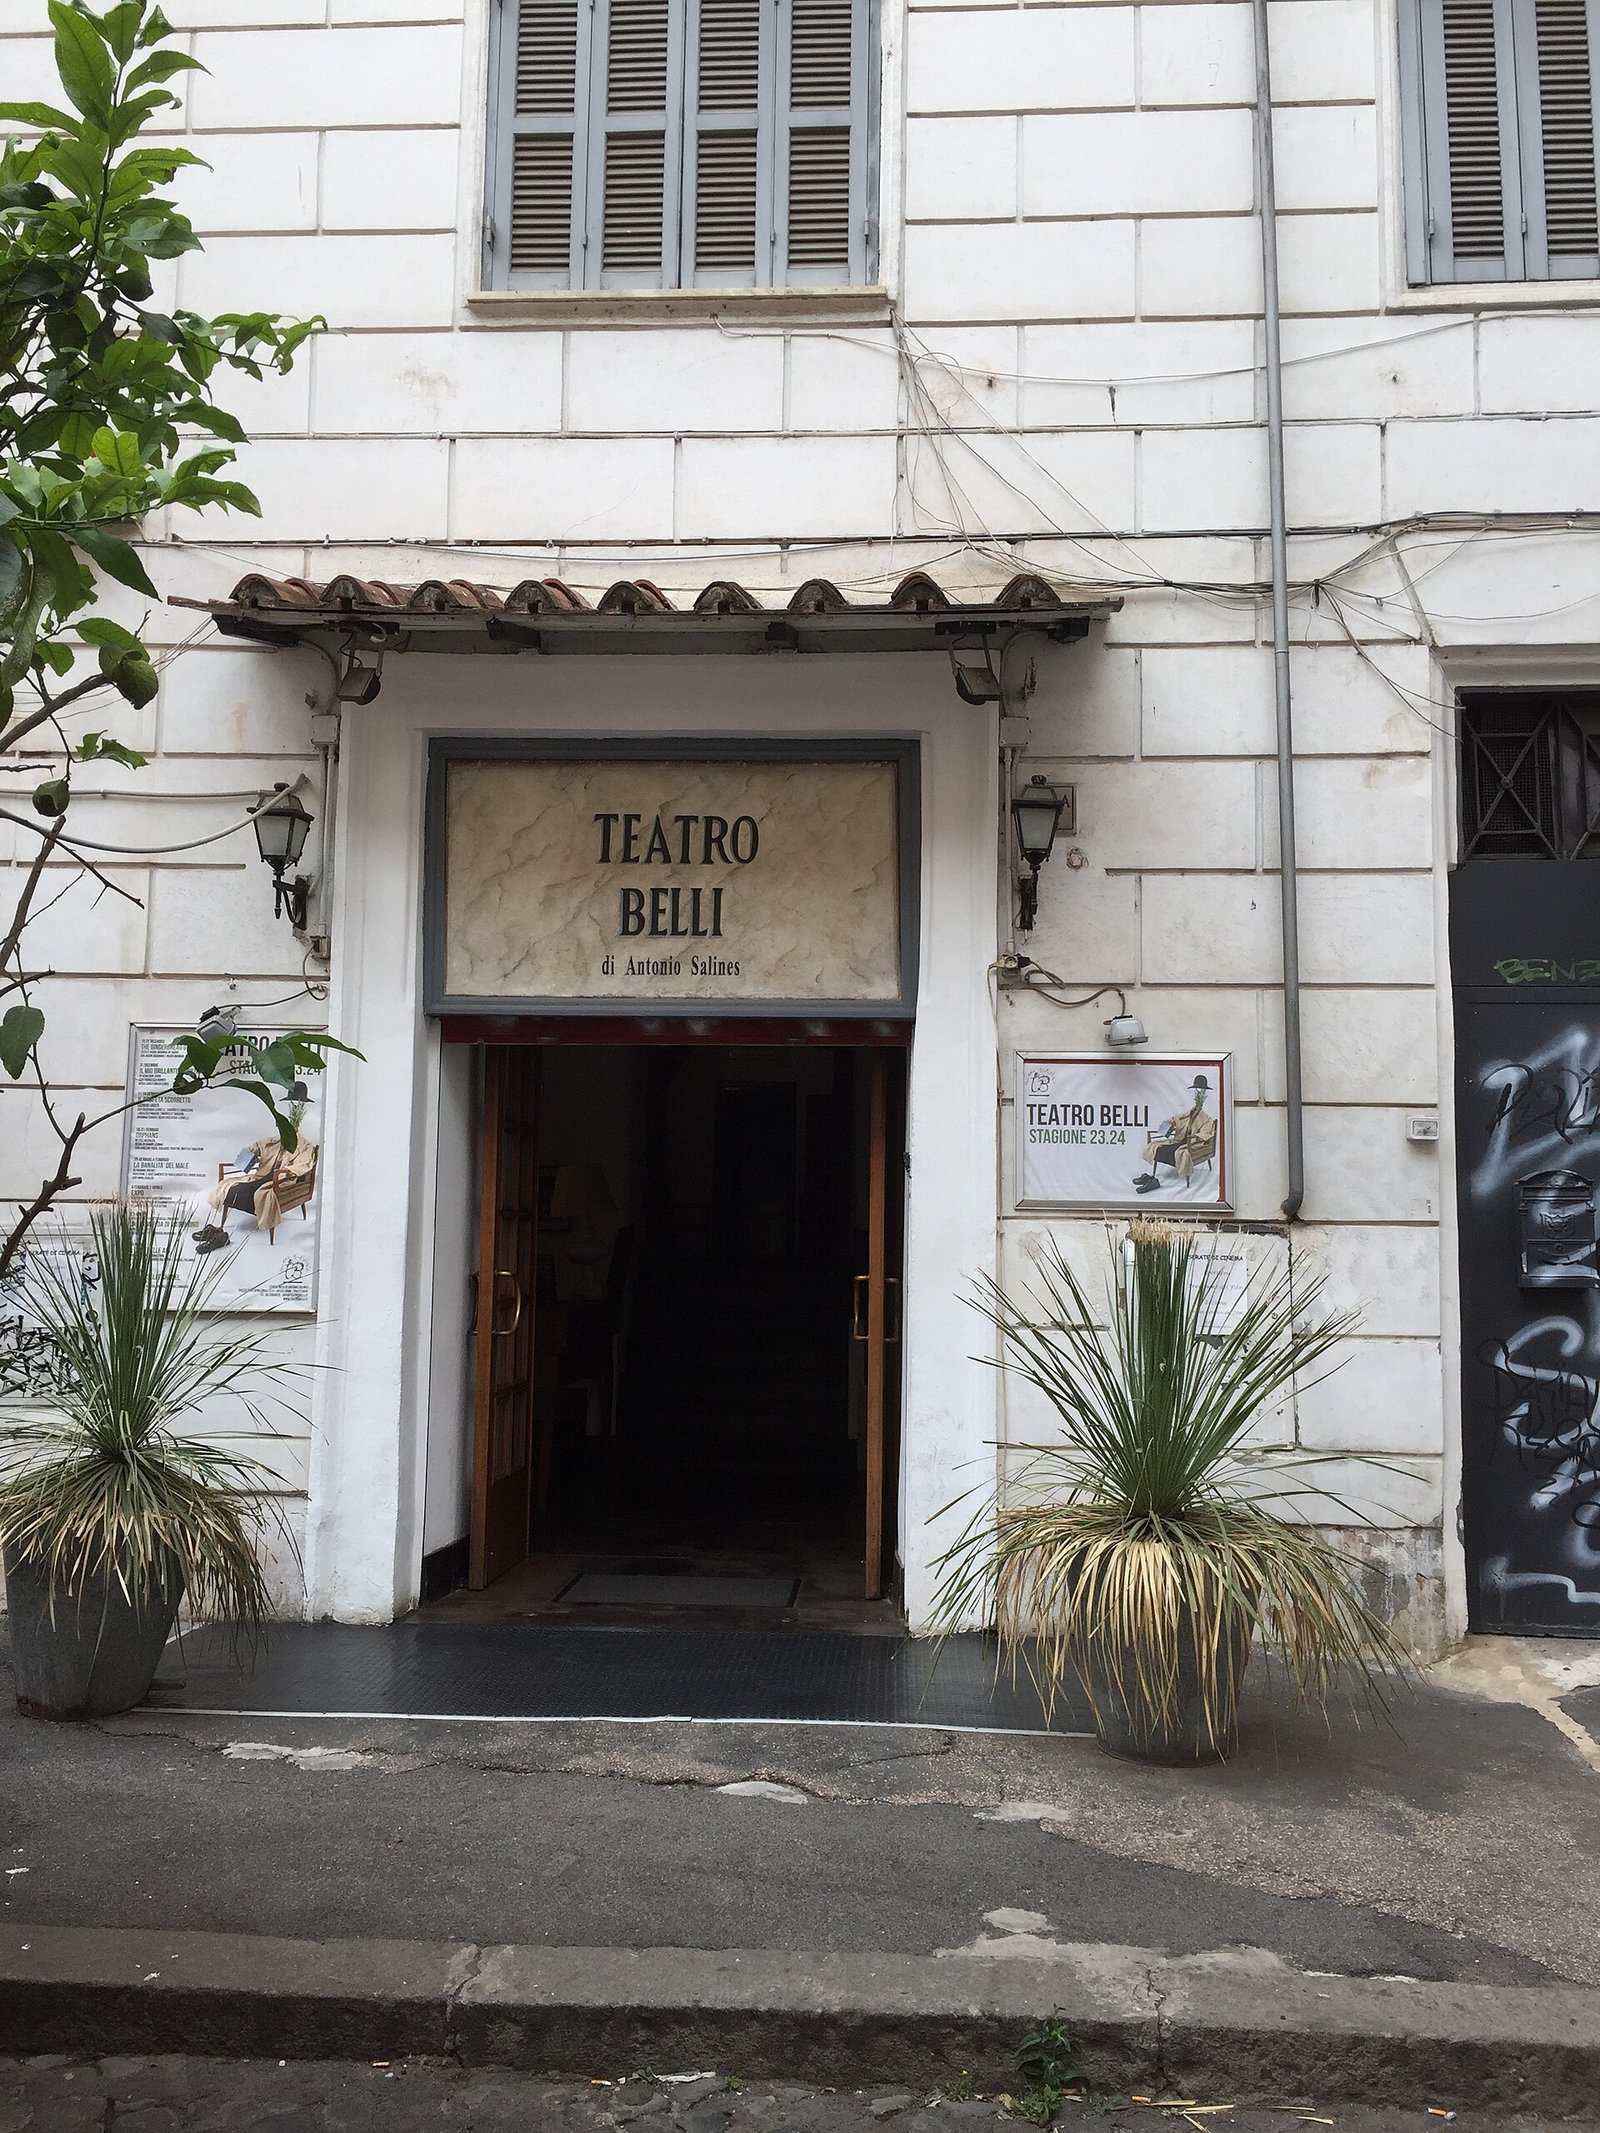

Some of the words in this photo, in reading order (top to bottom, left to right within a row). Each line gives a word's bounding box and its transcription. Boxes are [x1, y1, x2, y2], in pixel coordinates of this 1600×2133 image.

[593, 813, 760, 865] TEATRO
[618, 887, 724, 938] BELLI
[601, 955, 615, 976] di
[625, 956, 681, 976] Antonio
[691, 955, 741, 976] Salines
[1026, 1104, 1095, 1126] TEATRO
[1100, 1105, 1149, 1127] BELLI
[1029, 1129, 1087, 1144] STAGIONE
[1090, 1130, 1126, 1145] 23.24
